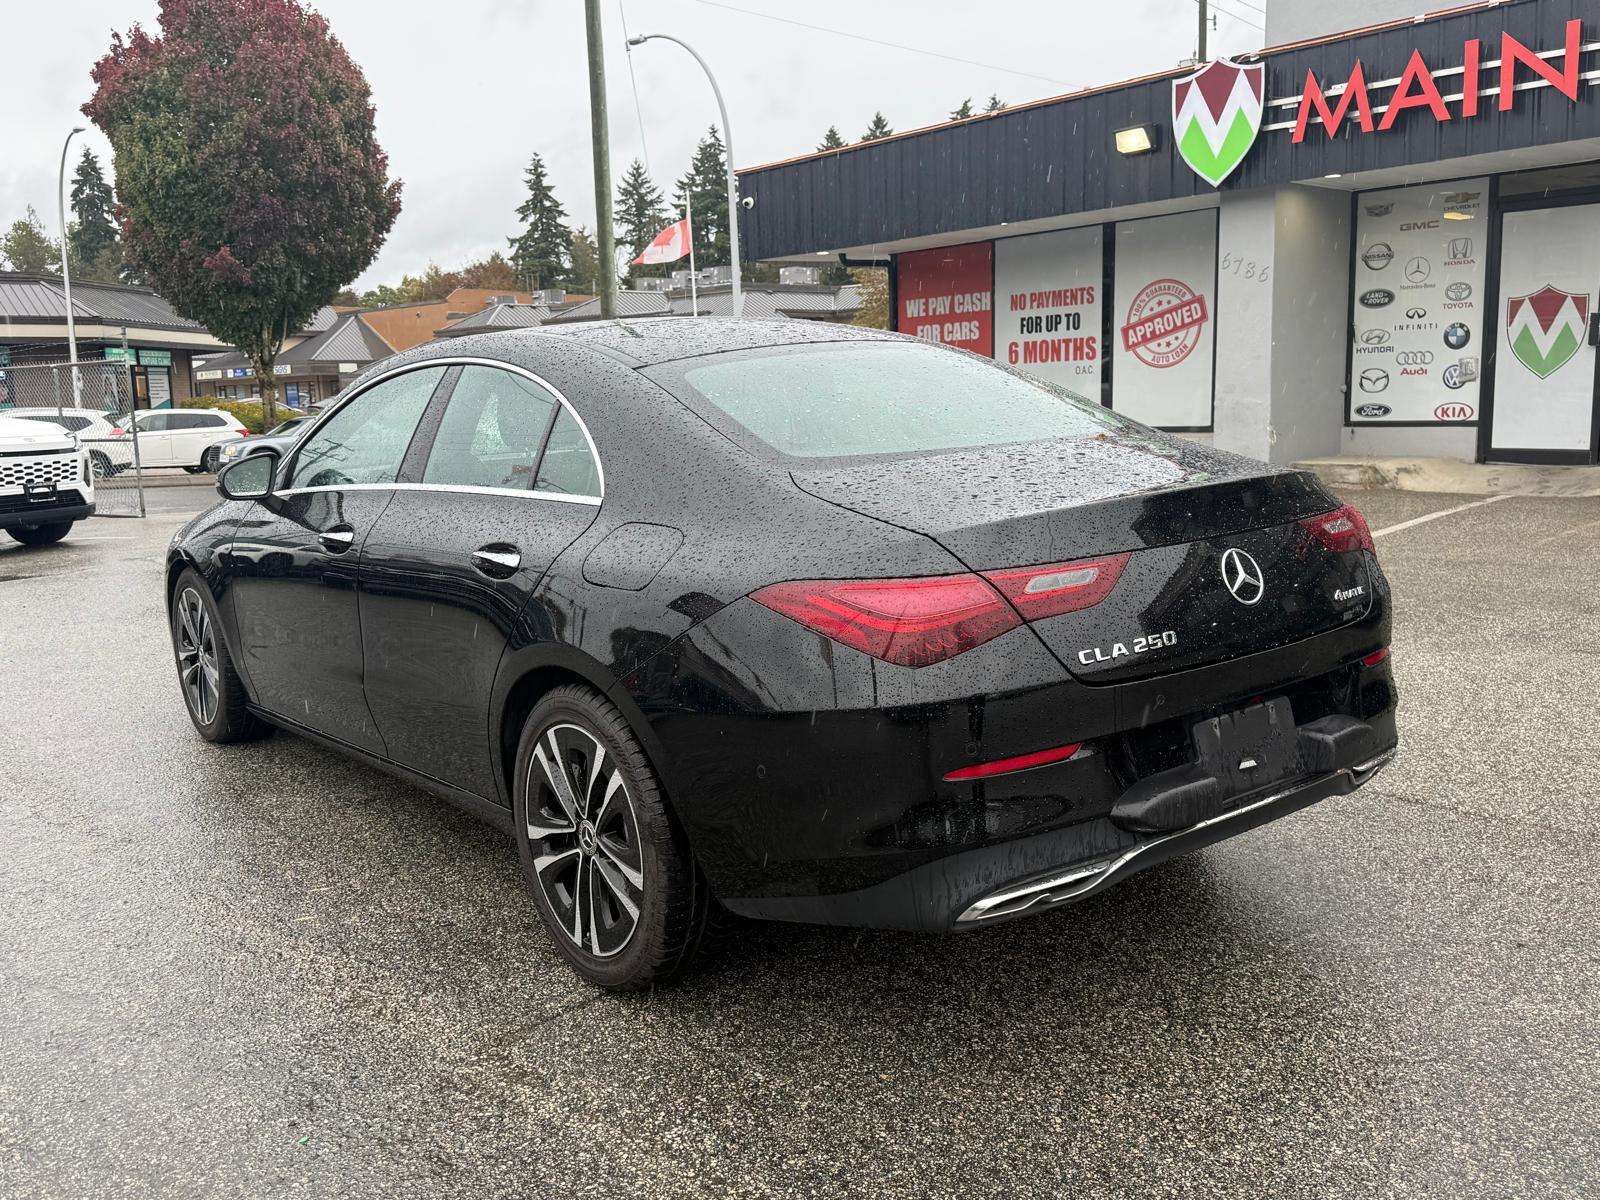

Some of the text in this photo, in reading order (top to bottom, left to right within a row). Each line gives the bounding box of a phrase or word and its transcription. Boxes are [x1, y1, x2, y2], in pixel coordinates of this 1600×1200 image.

[1291, 18, 1582, 144] MAIN
[1400, 220, 1440, 232] GMC
[1364, 252, 1392, 260] NISSAN
[1221, 252, 1270, 283] 6786
[906, 291, 991, 318] WE PAY CASH
[1010, 286, 1095, 311] NO PAYMENTS
[1133, 284, 1188, 317] 100% GUARANTEED
[1443, 302, 1474, 310] TOYOTA
[917, 320, 979, 342] FOR CARS
[1020, 312, 1081, 334] FOR UP TO
[1128, 302, 1202, 346] APPROVED
[1394, 323, 1438, 331] INFINITI
[1008, 336, 1097, 365] 6 MONTHS
[1151, 343, 1189, 363] AUTO LOAN
[1356, 346, 1394, 354] HYUNDAI
[1400, 367, 1428, 376] Audi
[1362, 405, 1385, 417] Ford
[1440, 406, 1468, 418] KIA
[1078, 630, 1177, 665] CLA 250
